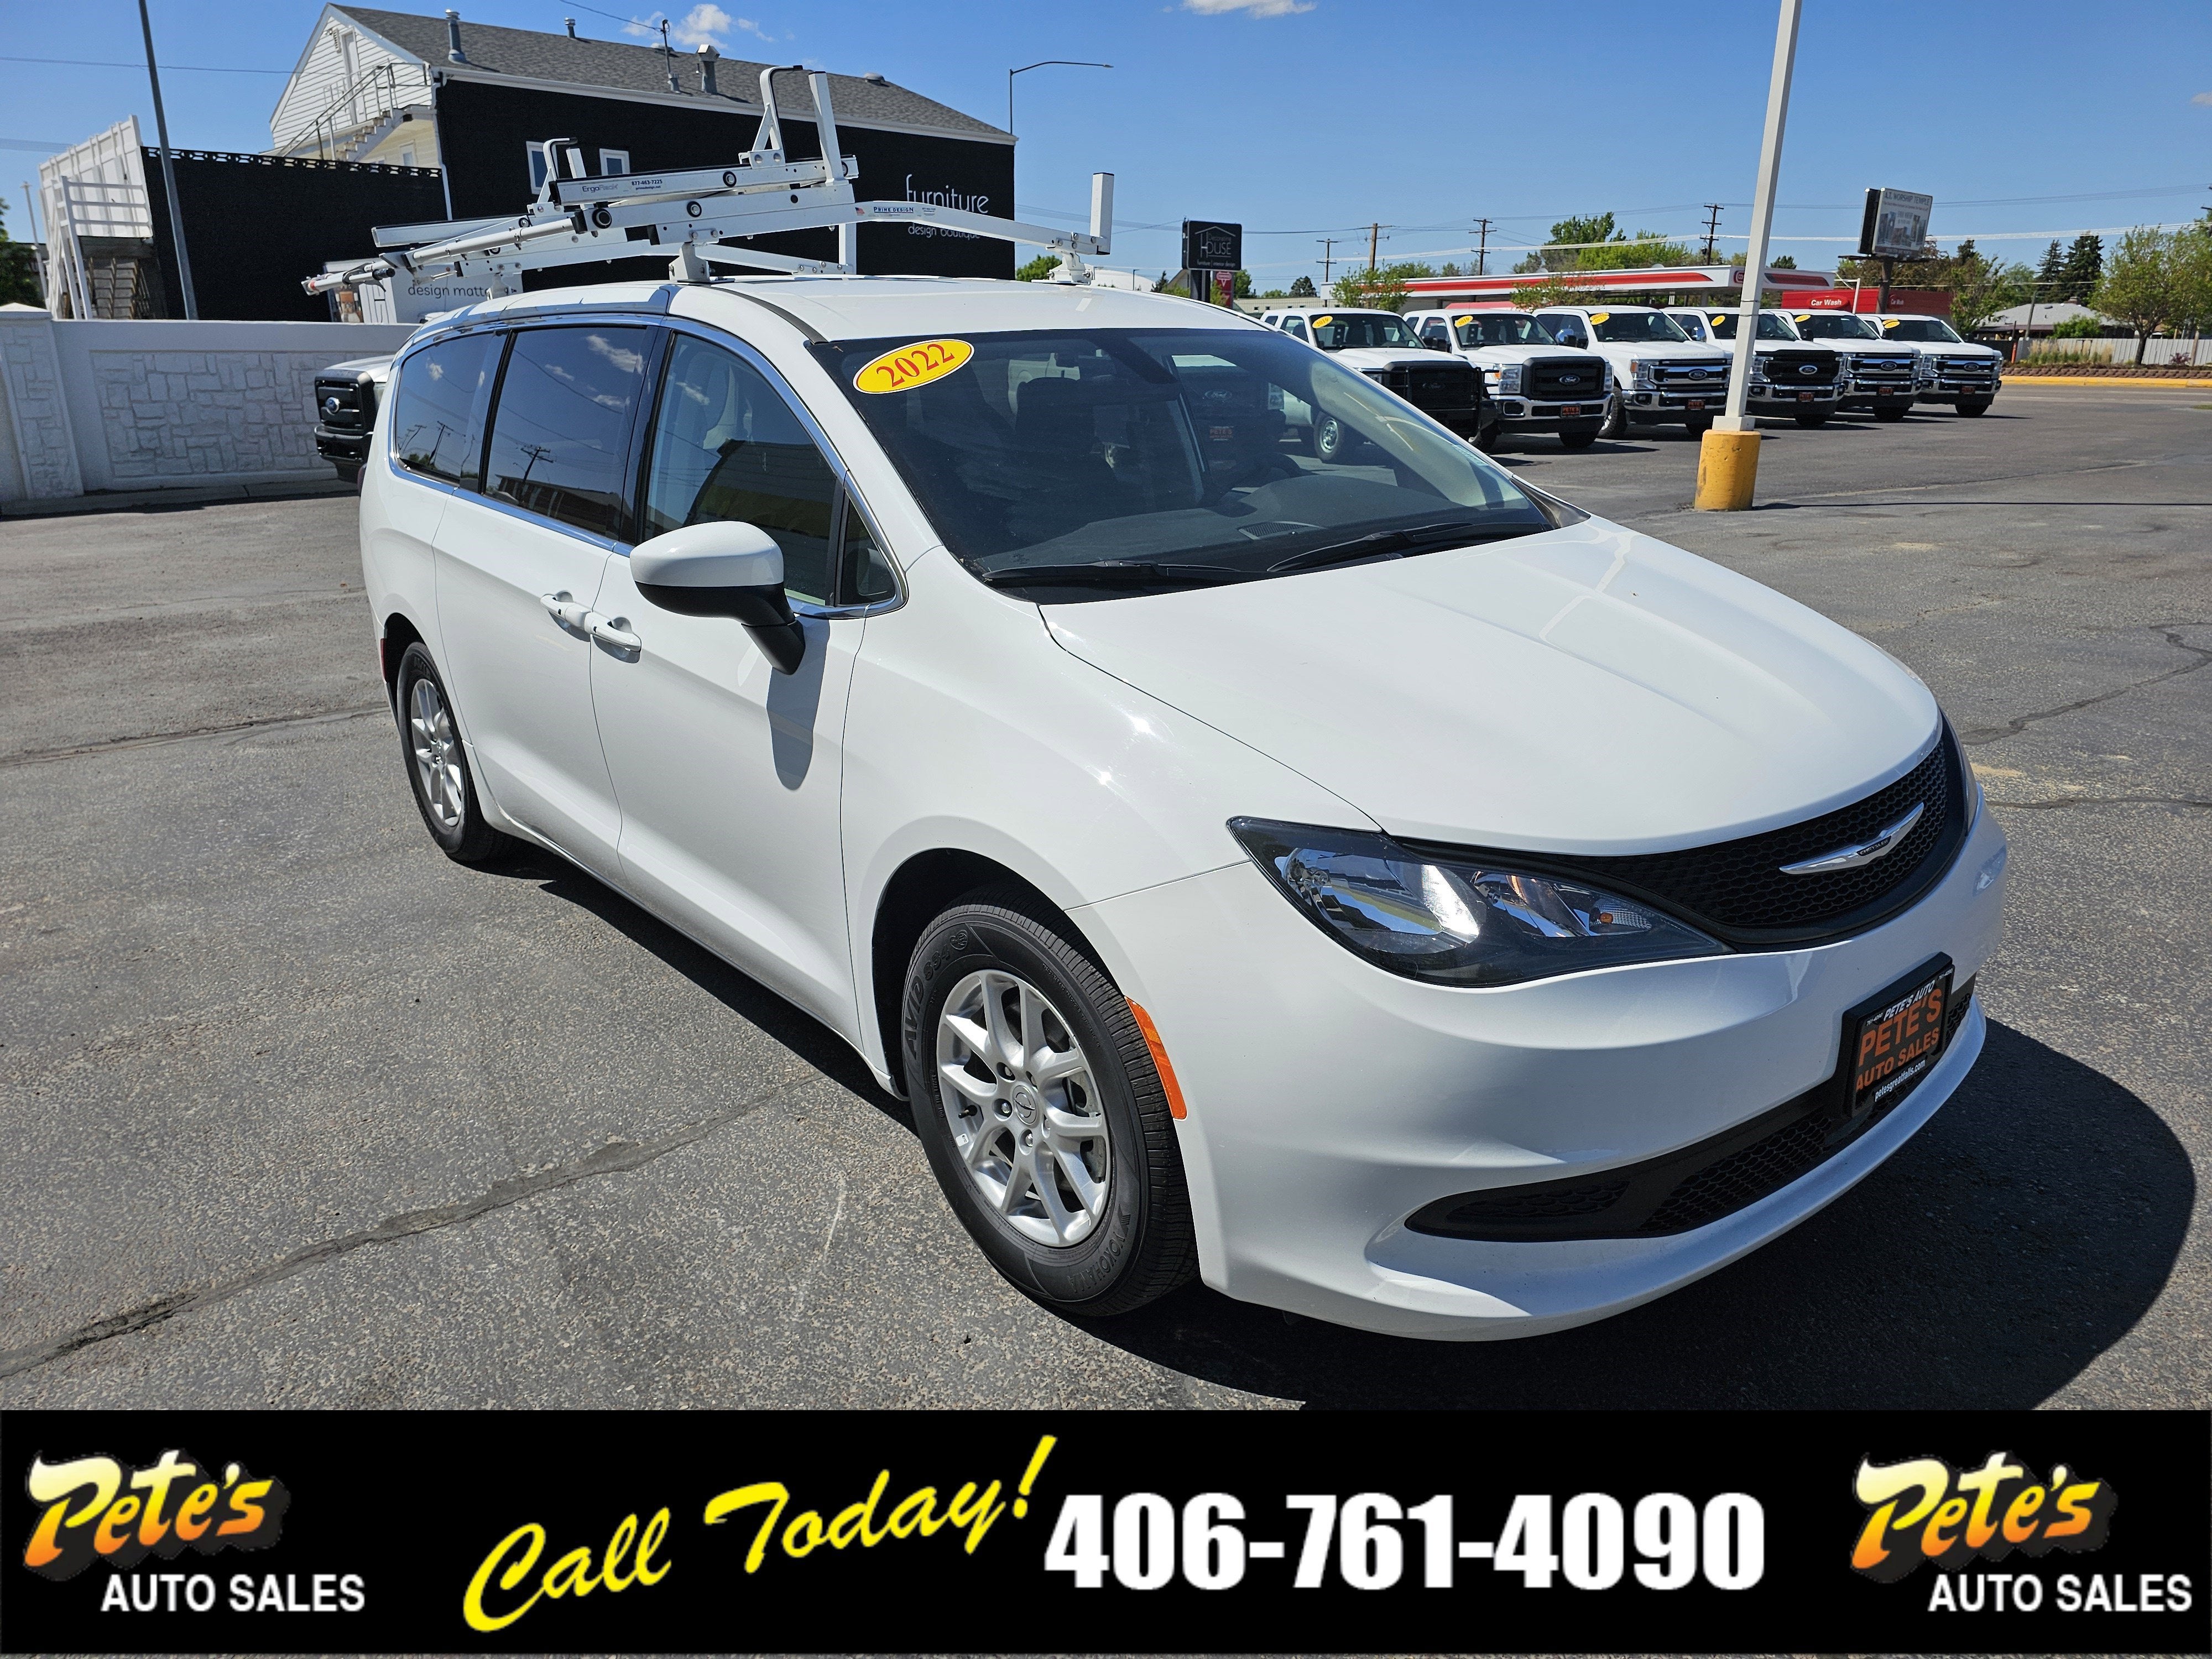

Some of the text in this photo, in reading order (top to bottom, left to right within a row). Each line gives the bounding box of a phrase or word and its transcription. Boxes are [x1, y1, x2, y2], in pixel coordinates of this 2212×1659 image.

[906, 174, 989, 213] furniture
[908, 223, 937, 238] design
[408, 284, 450, 299] design
[876, 343, 955, 387] 2022
[1860, 838, 1888, 855] CHRYSLER
[904, 975, 924, 1060] AVID
[1884, 994, 1914, 1021] PETE'S
[1912, 979, 1936, 1004] AUTO
[1858, 988, 1942, 1067] PETE'S
[1855, 1027, 1939, 1092] AUTO SALES
[1875, 1060, 1926, 1102] petesgreatfalls.com
[1067, 1231, 1125, 1293] YOKOHAMA
